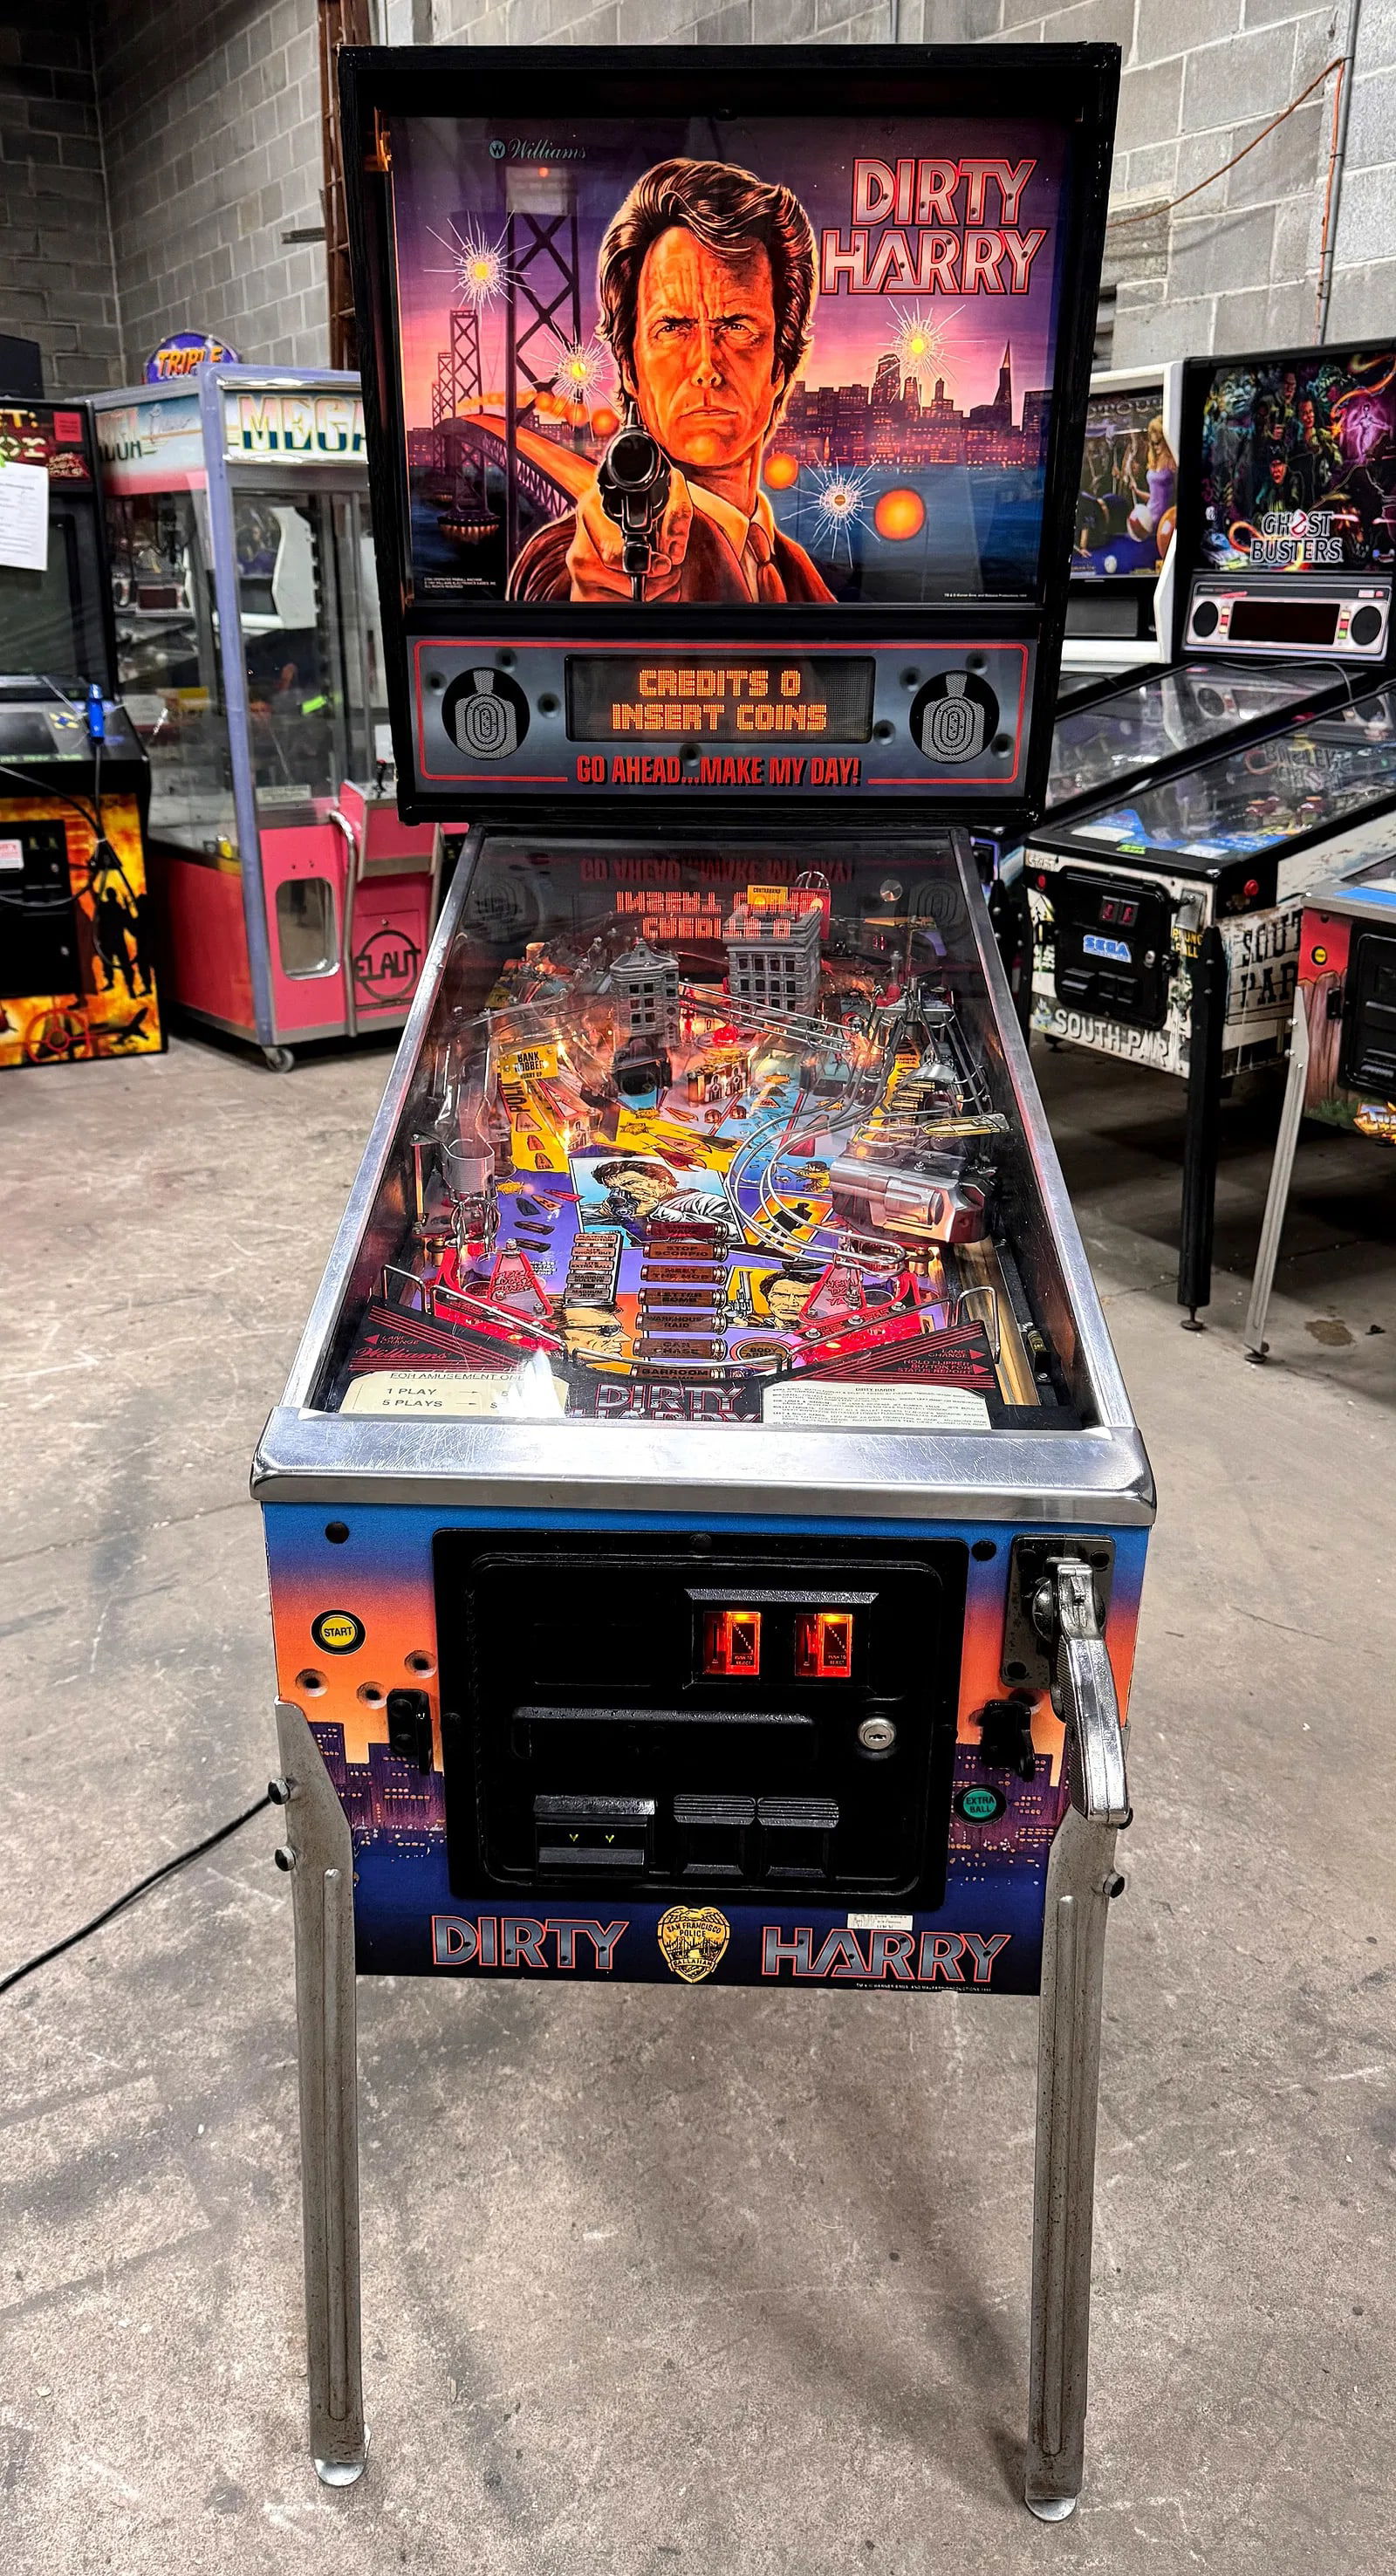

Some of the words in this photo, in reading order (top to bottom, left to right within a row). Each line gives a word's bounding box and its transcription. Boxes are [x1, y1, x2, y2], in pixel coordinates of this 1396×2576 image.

[507, 138, 587, 159] Williams
[852, 158, 1037, 227] DIRTY
[820, 228, 1047, 297] HARRY
[1250, 538, 1344, 564] BUSTERS
[638, 669, 769, 697] CREDITS
[612, 703, 726, 730] INSERT
[736, 704, 828, 731] COINS
[576, 755, 607, 783] GO
[769, 757, 805, 784] MY
[810, 757, 861, 784] DAY!
[1084, 935, 1130, 956] SEGA
[353, 949, 421, 982] ELAUT
[1054, 1008, 1121, 1052] SOUTH
[1126, 1028, 1185, 1073] PARK
[355, 1346, 448, 1359] Williams
[394, 1399, 443, 1408] PLAYS
[596, 1383, 746, 1411] DIRTY
[324, 1627, 352, 1637] START
[966, 1796, 994, 1805] EXTRA
[666, 1922, 681, 1932] SAN
[682, 1922, 722, 1934] FRANCISCO
[431, 1915, 630, 1970] DIRTY
[761, 1927, 1011, 1983] HARRY
